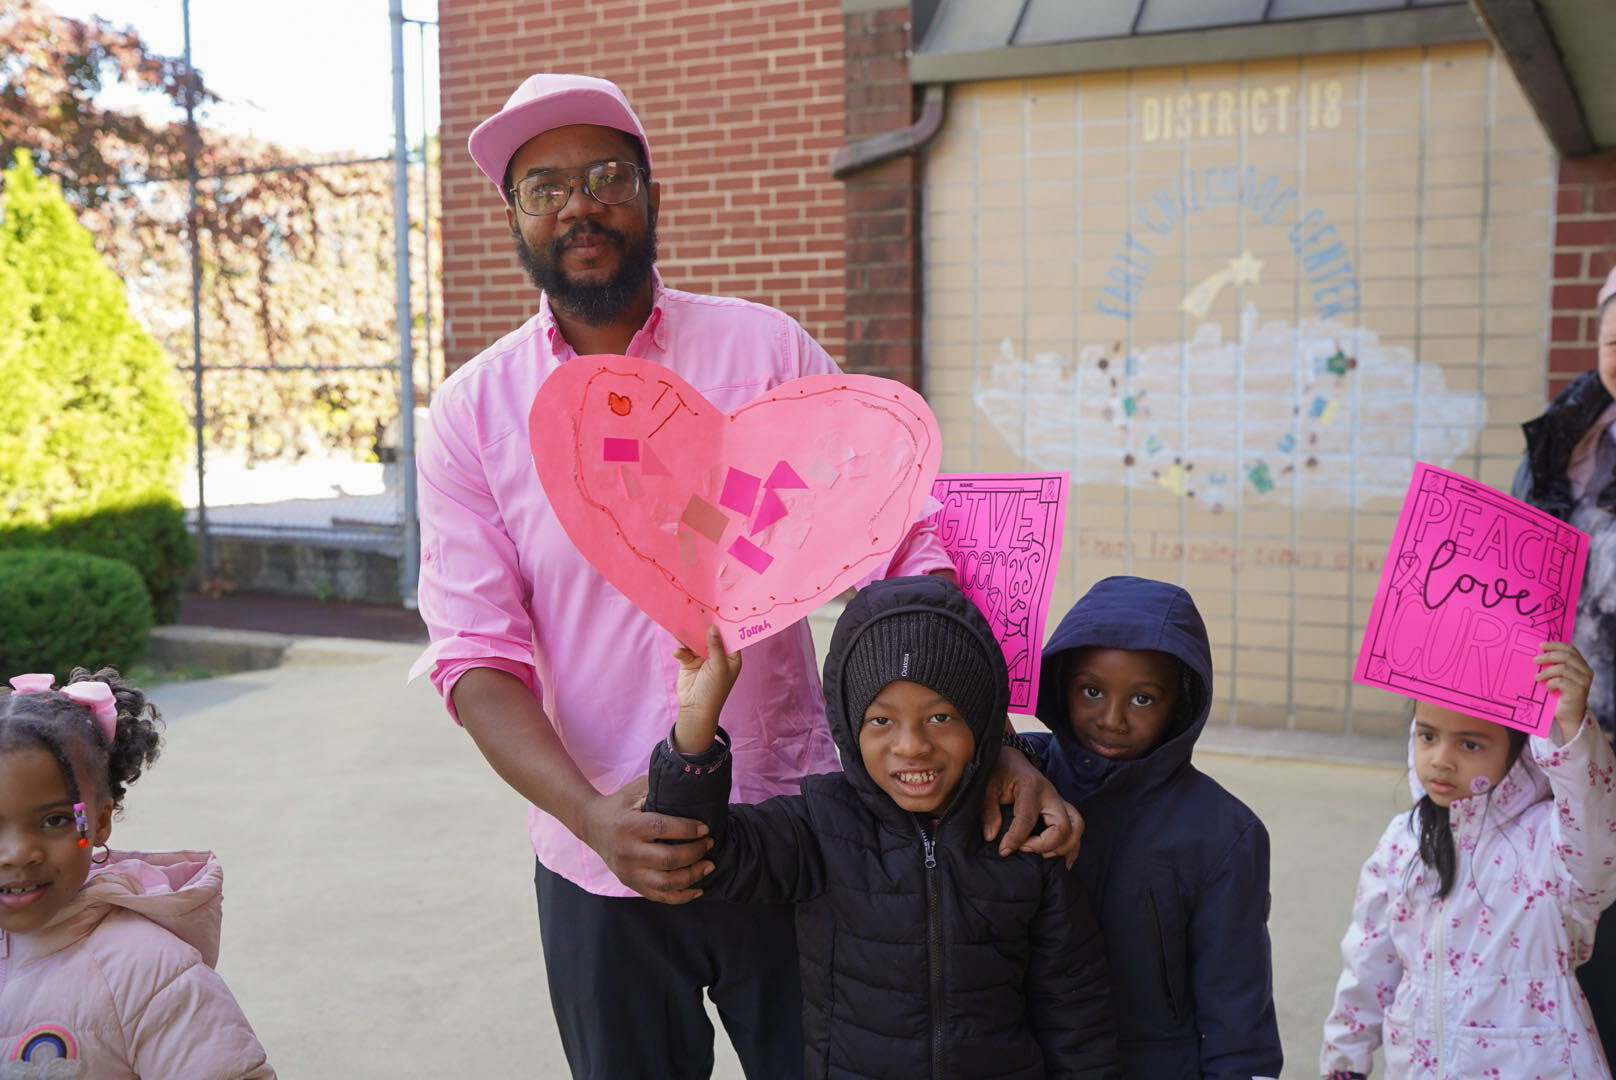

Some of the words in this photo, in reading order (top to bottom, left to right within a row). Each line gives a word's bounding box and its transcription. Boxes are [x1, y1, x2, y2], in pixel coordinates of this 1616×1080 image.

[1143, 85, 1292, 142] DISTRICT
[1309, 79, 1344, 129] 18
[938, 491, 1039, 552] GIVE
[1414, 491, 1568, 593] PEACE
[944, 549, 1007, 590] ncer
[1423, 539, 1542, 616] love
[1385, 593, 1549, 710] CURE
